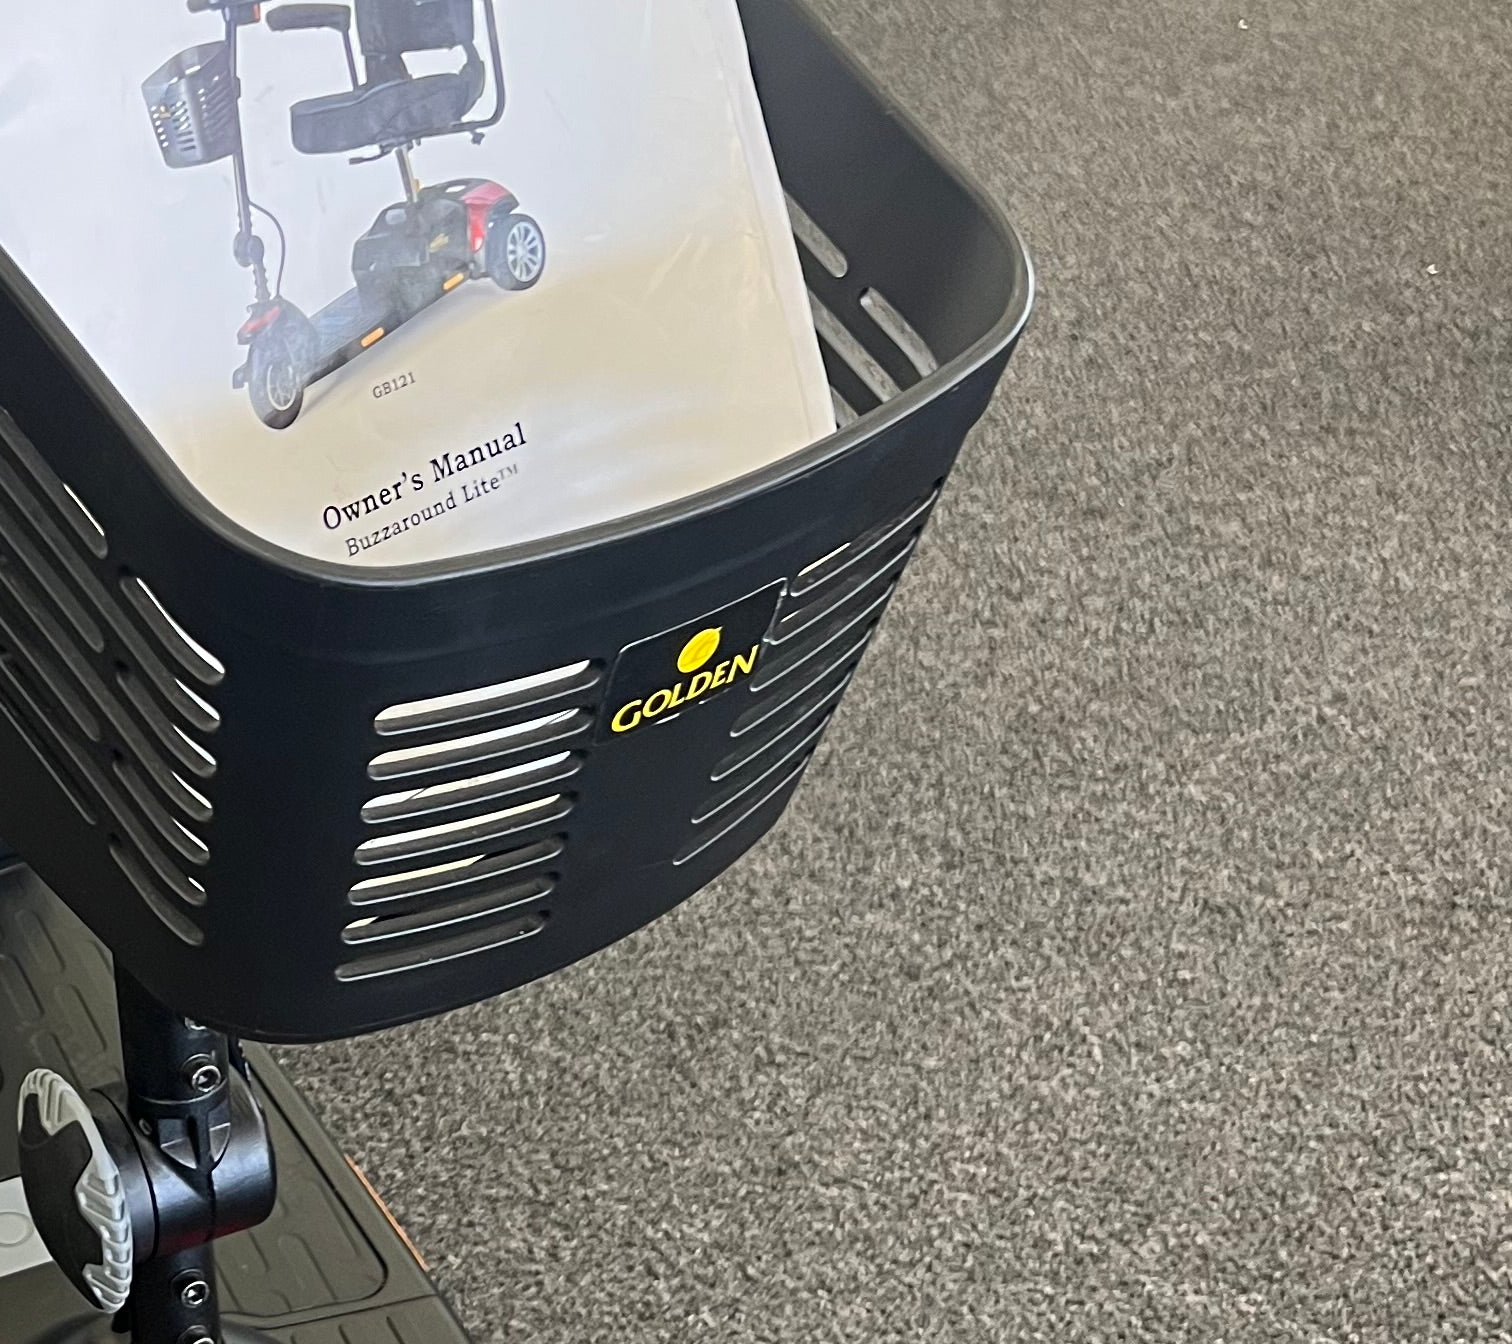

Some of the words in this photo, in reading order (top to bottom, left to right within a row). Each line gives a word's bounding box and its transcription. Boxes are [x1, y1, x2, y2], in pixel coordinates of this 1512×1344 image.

[372, 371, 416, 399] GB121
[323, 471, 424, 531] Owner's
[429, 421, 527, 483] Manual
[344, 491, 457, 557] Buzzaround
[611, 644, 760, 733] GOLDEN
